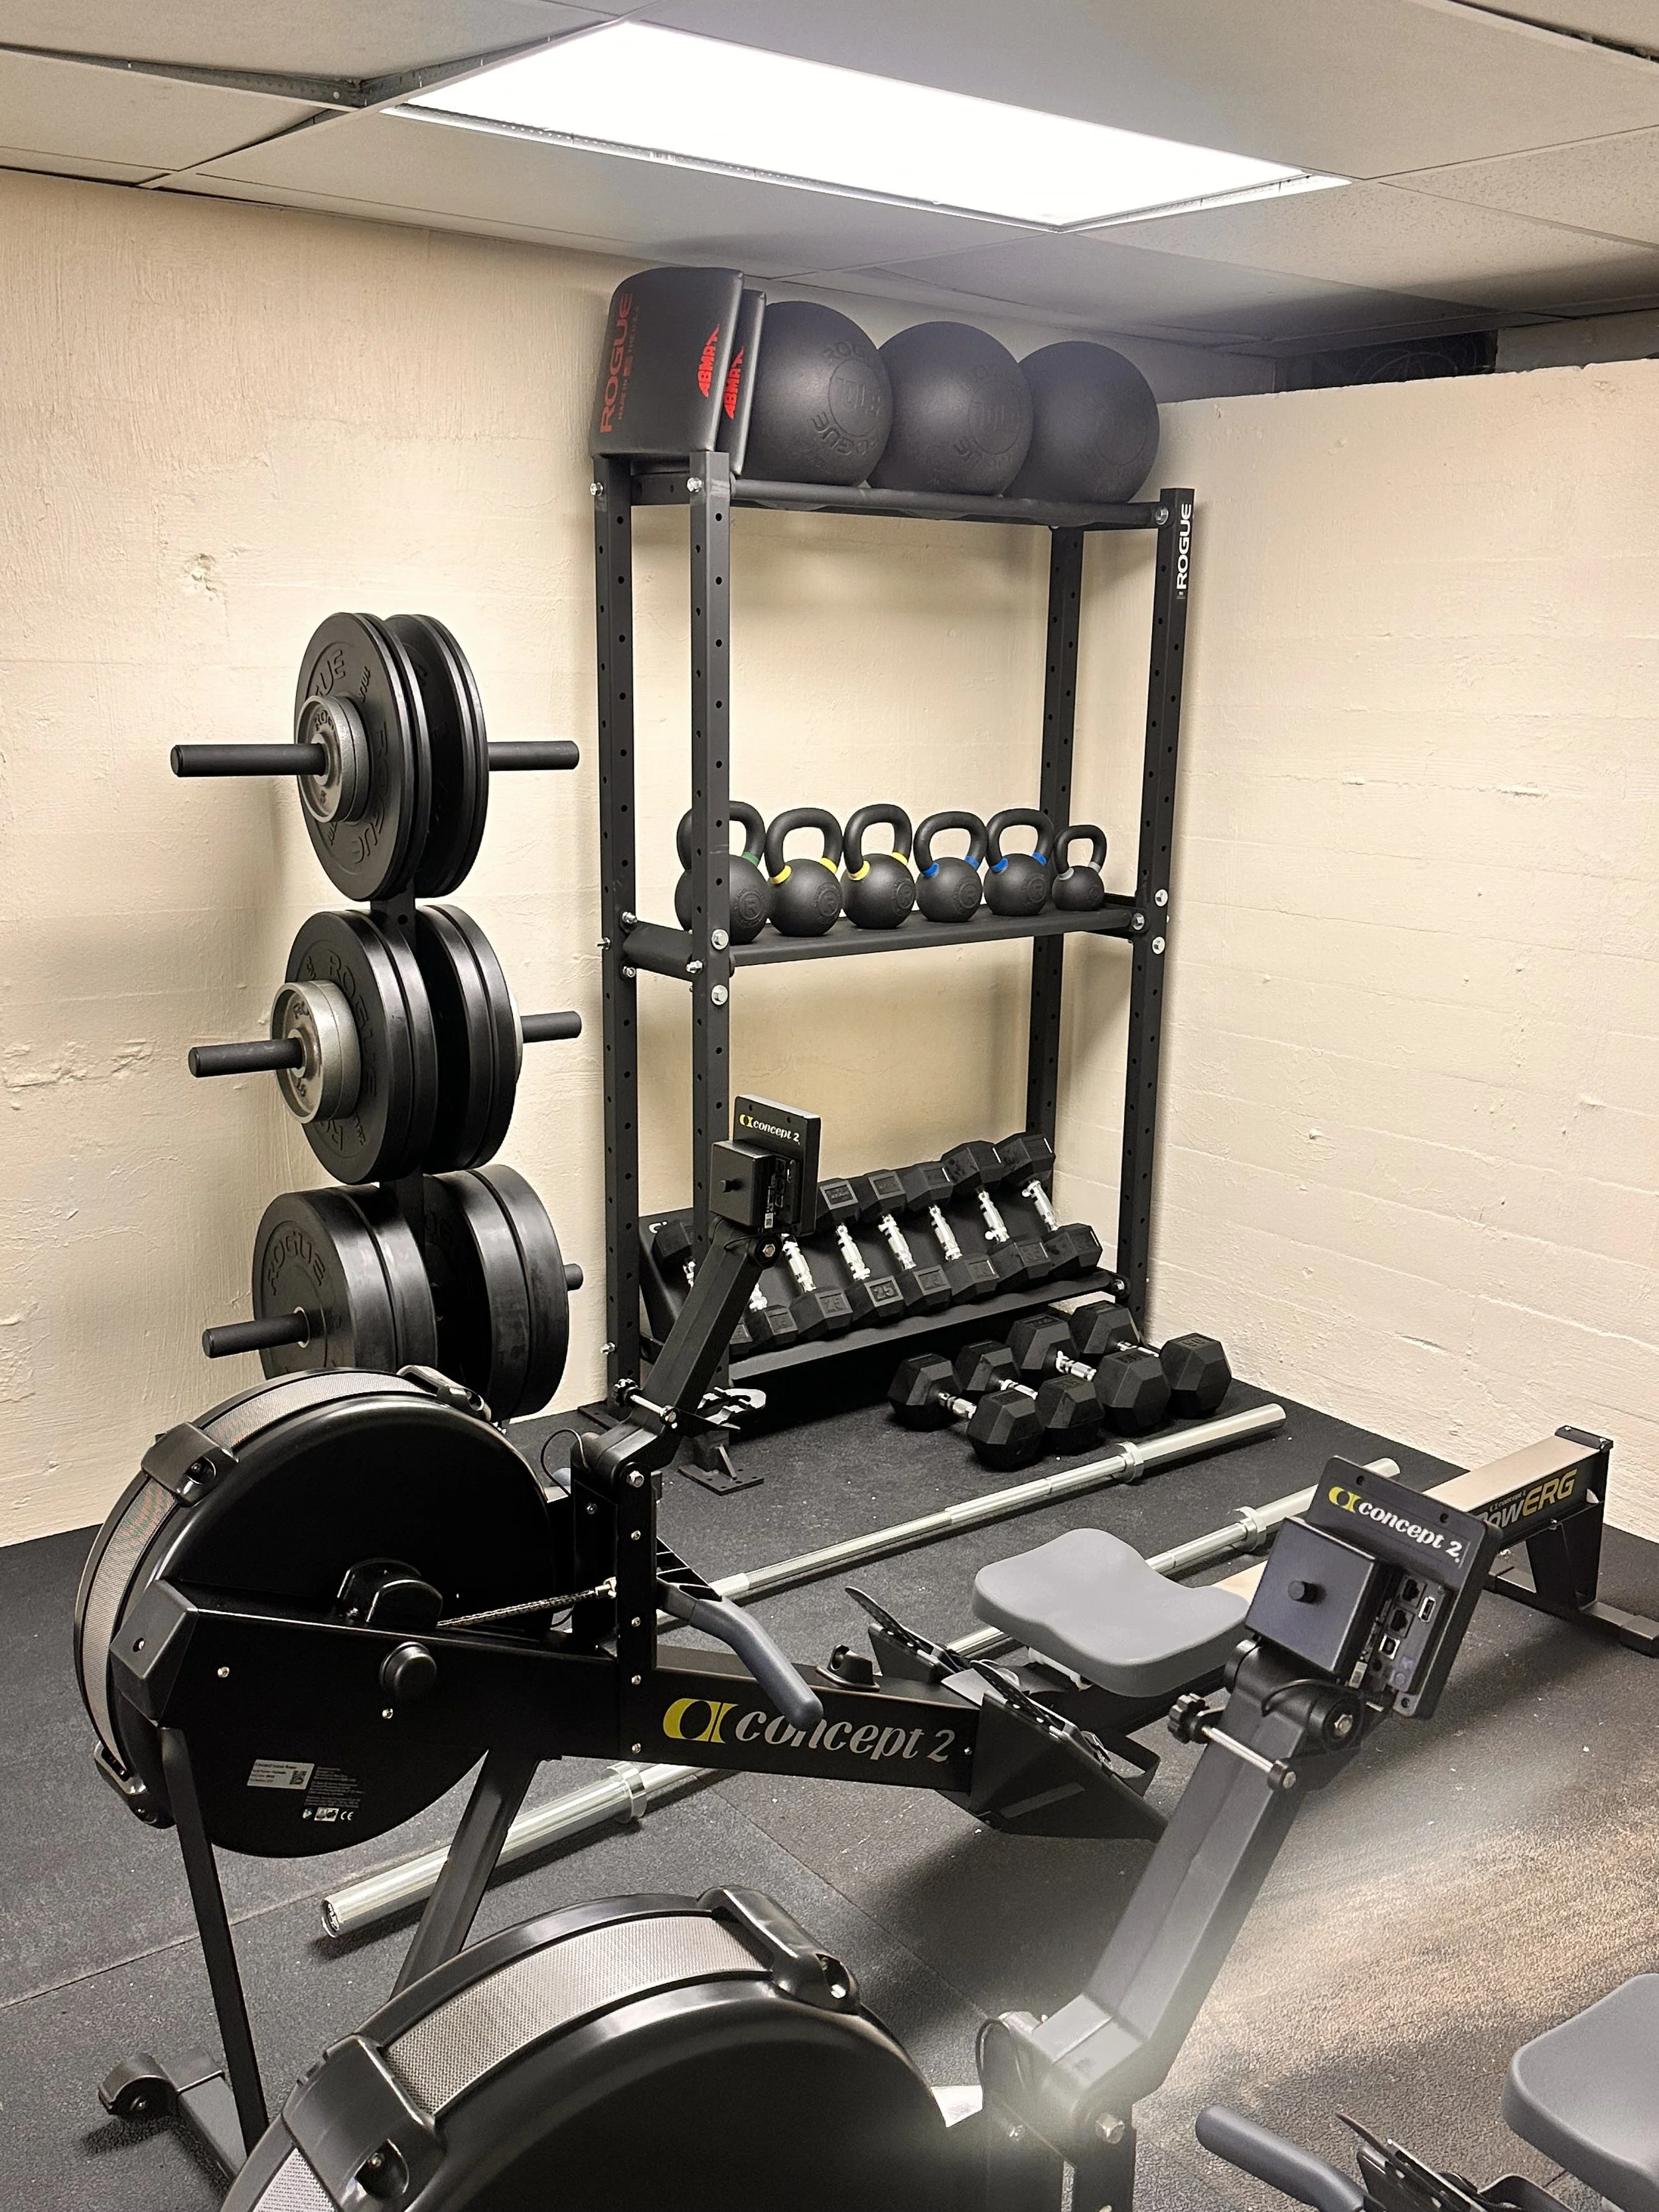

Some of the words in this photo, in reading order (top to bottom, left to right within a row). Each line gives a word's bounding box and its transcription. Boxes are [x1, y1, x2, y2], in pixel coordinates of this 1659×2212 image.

[599, 293, 633, 433] ROGUE
[1176, 503, 1192, 590] ROGUE
[753, 1120, 792, 1139] concept
[266, 1230, 326, 1297] ROGUE
[872, 1284, 896, 1301] 25
[1358, 1500, 1445, 1549] concept
[1445, 1539, 1462, 1560] 2
[927, 1728, 956, 1763] 2
